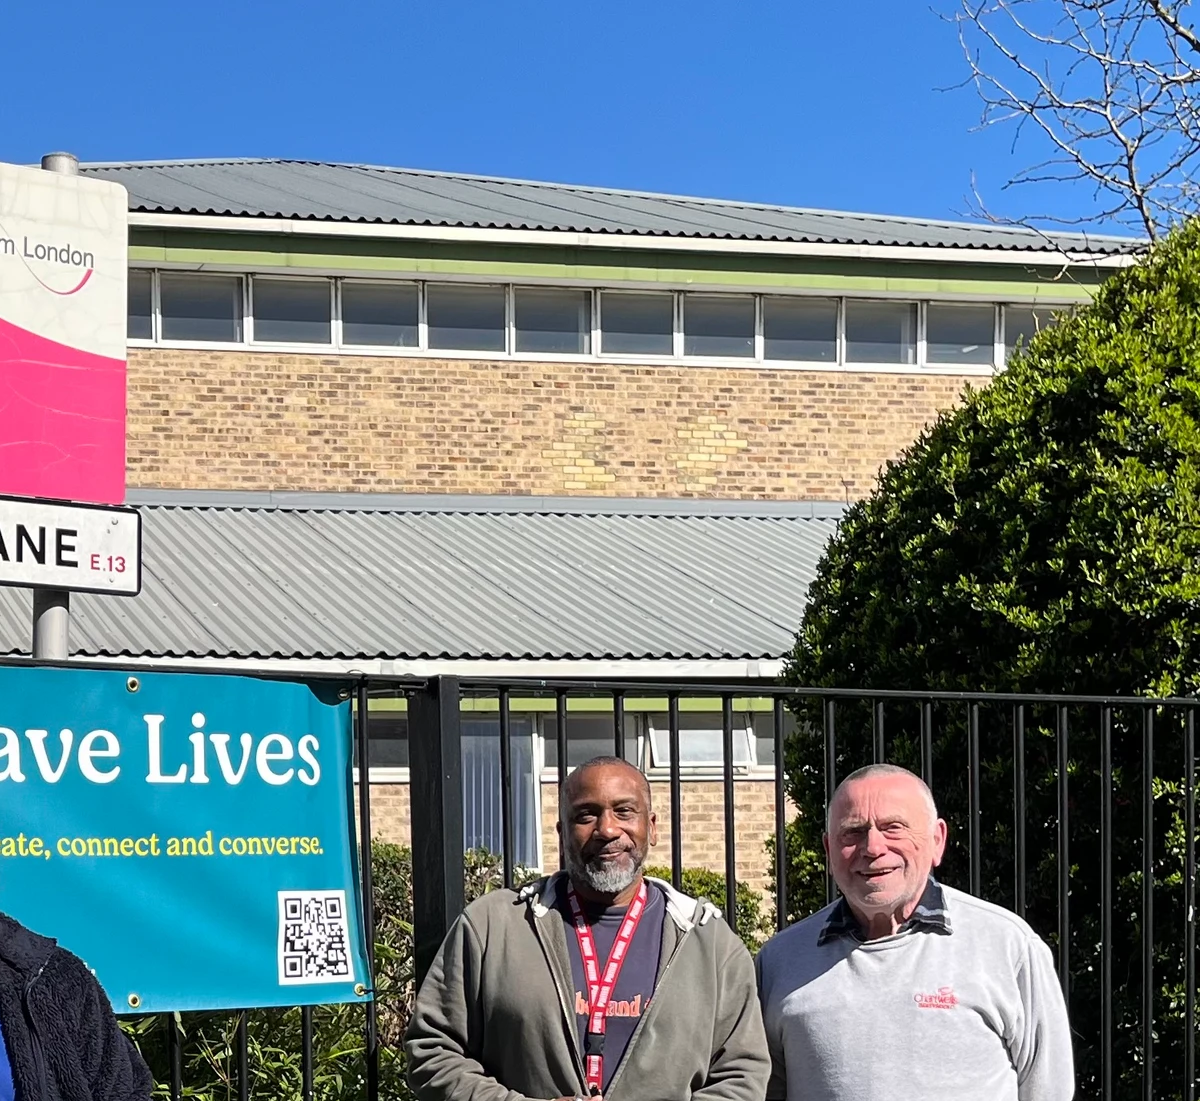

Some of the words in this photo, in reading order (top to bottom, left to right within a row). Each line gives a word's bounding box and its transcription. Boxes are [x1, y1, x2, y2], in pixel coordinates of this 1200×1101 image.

[23, 236, 94, 269] London
[90, 553, 126, 573] E.13
[143, 712, 321, 786] Lives
[56, 834, 161, 857] connect
[167, 831, 215, 856] and
[218, 837, 324, 856] converse.
